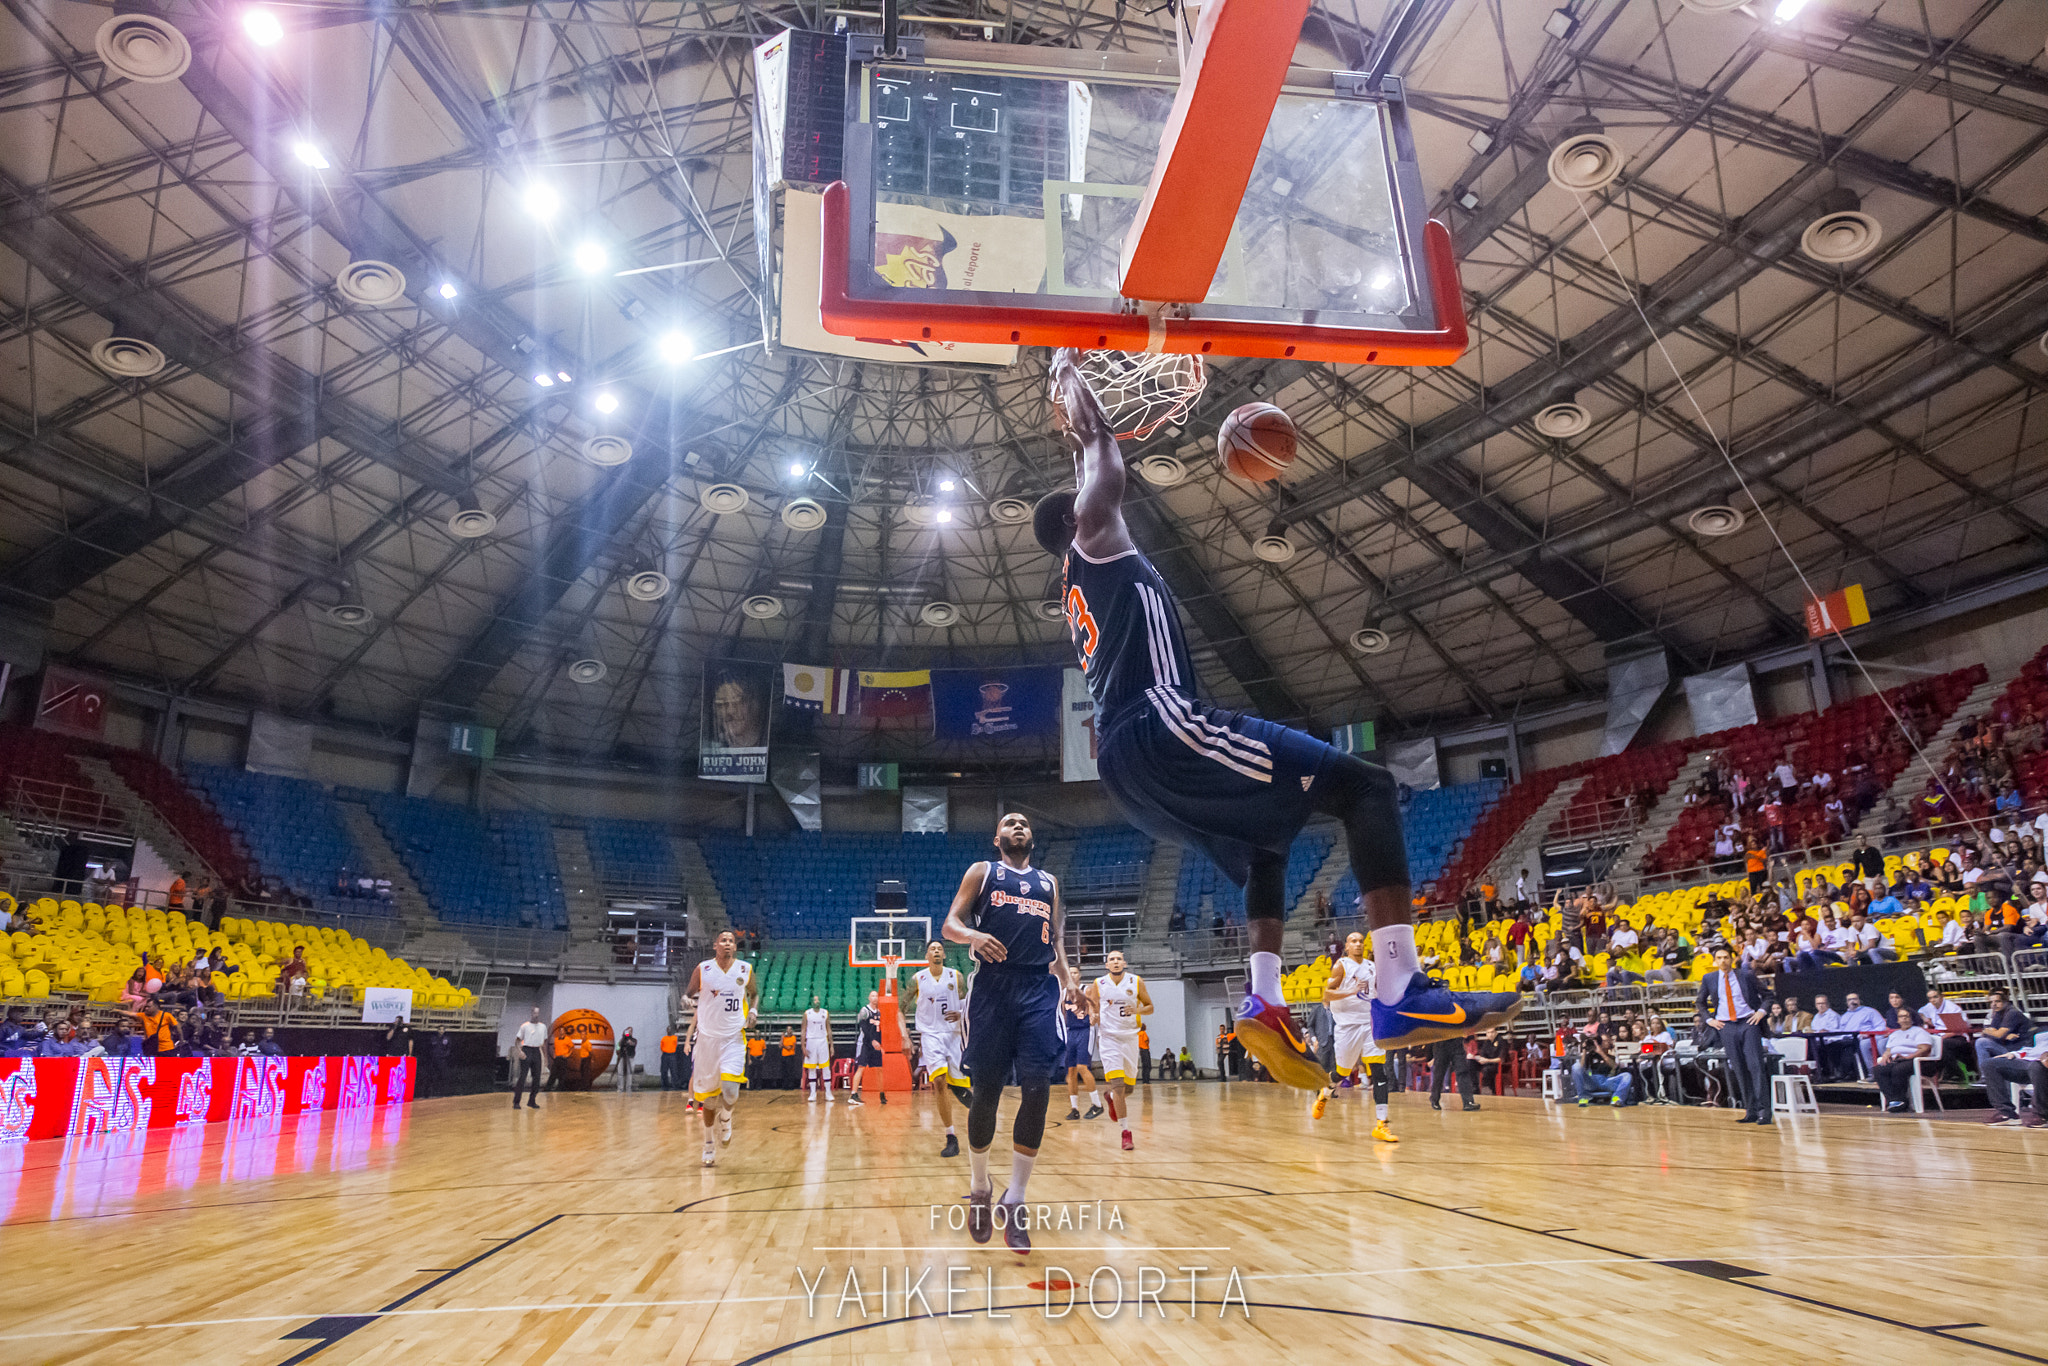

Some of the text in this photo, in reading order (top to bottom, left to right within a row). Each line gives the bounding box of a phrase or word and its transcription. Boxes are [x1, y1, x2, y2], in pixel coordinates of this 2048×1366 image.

[963, 241, 982, 278] deporte
[462, 728, 473, 752] L
[703, 756, 767, 767] RUFO JOHN
[869, 766, 883, 787] K
[1041, 921, 1050, 945] 6
[724, 998, 740, 1012] 30
[565, 1023, 609, 1036] GOLTY
